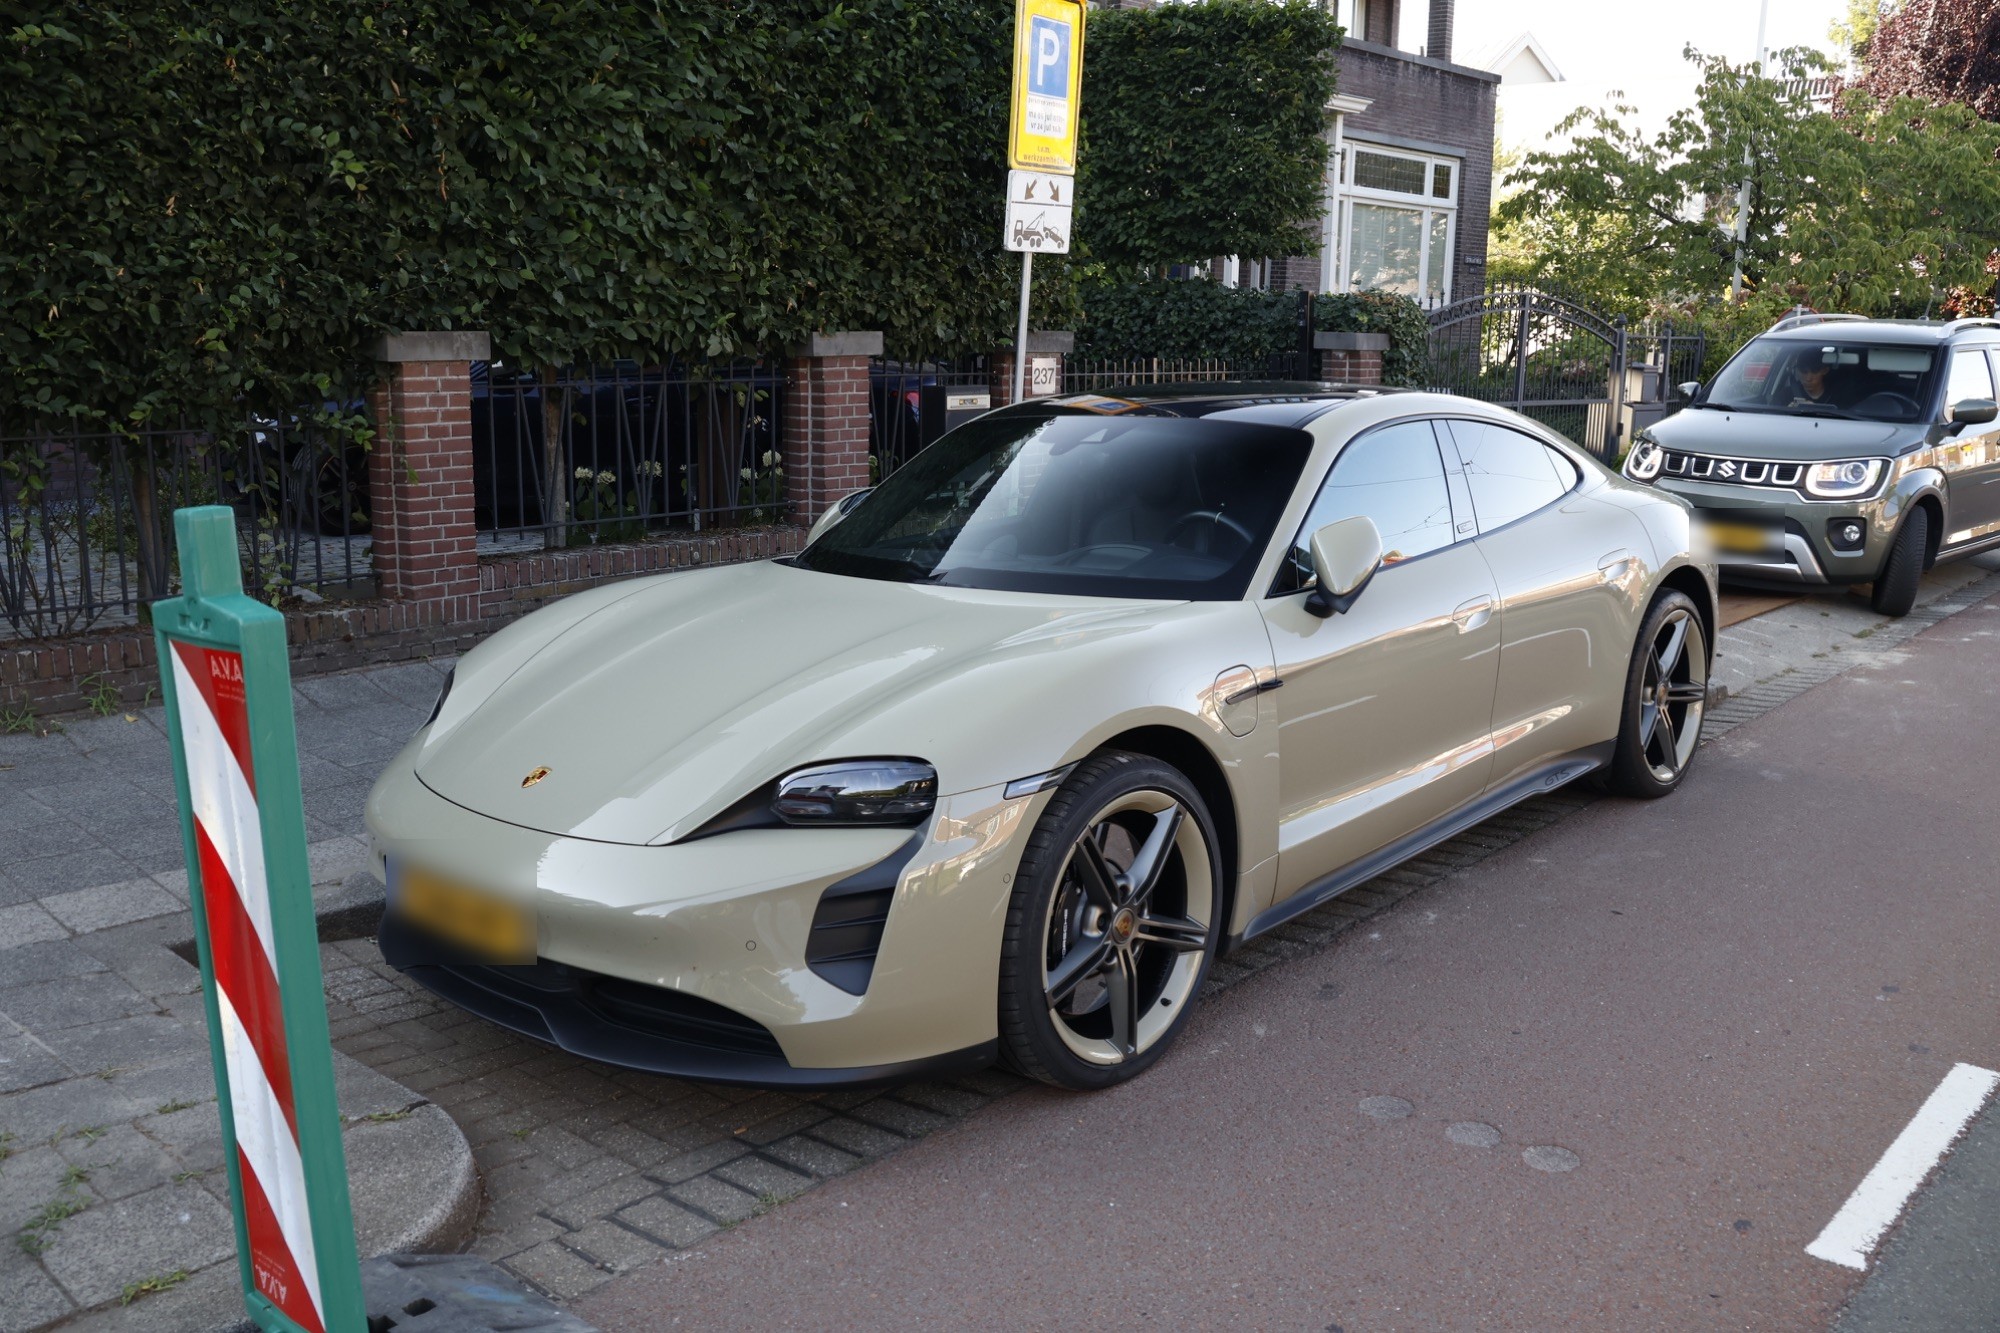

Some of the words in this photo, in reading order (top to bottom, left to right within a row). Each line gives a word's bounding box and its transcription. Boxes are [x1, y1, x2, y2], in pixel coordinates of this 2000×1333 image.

[1037, 27, 1060, 86] P
[1033, 367, 1055, 385] 237
[1545, 768, 1570, 786] GTS
